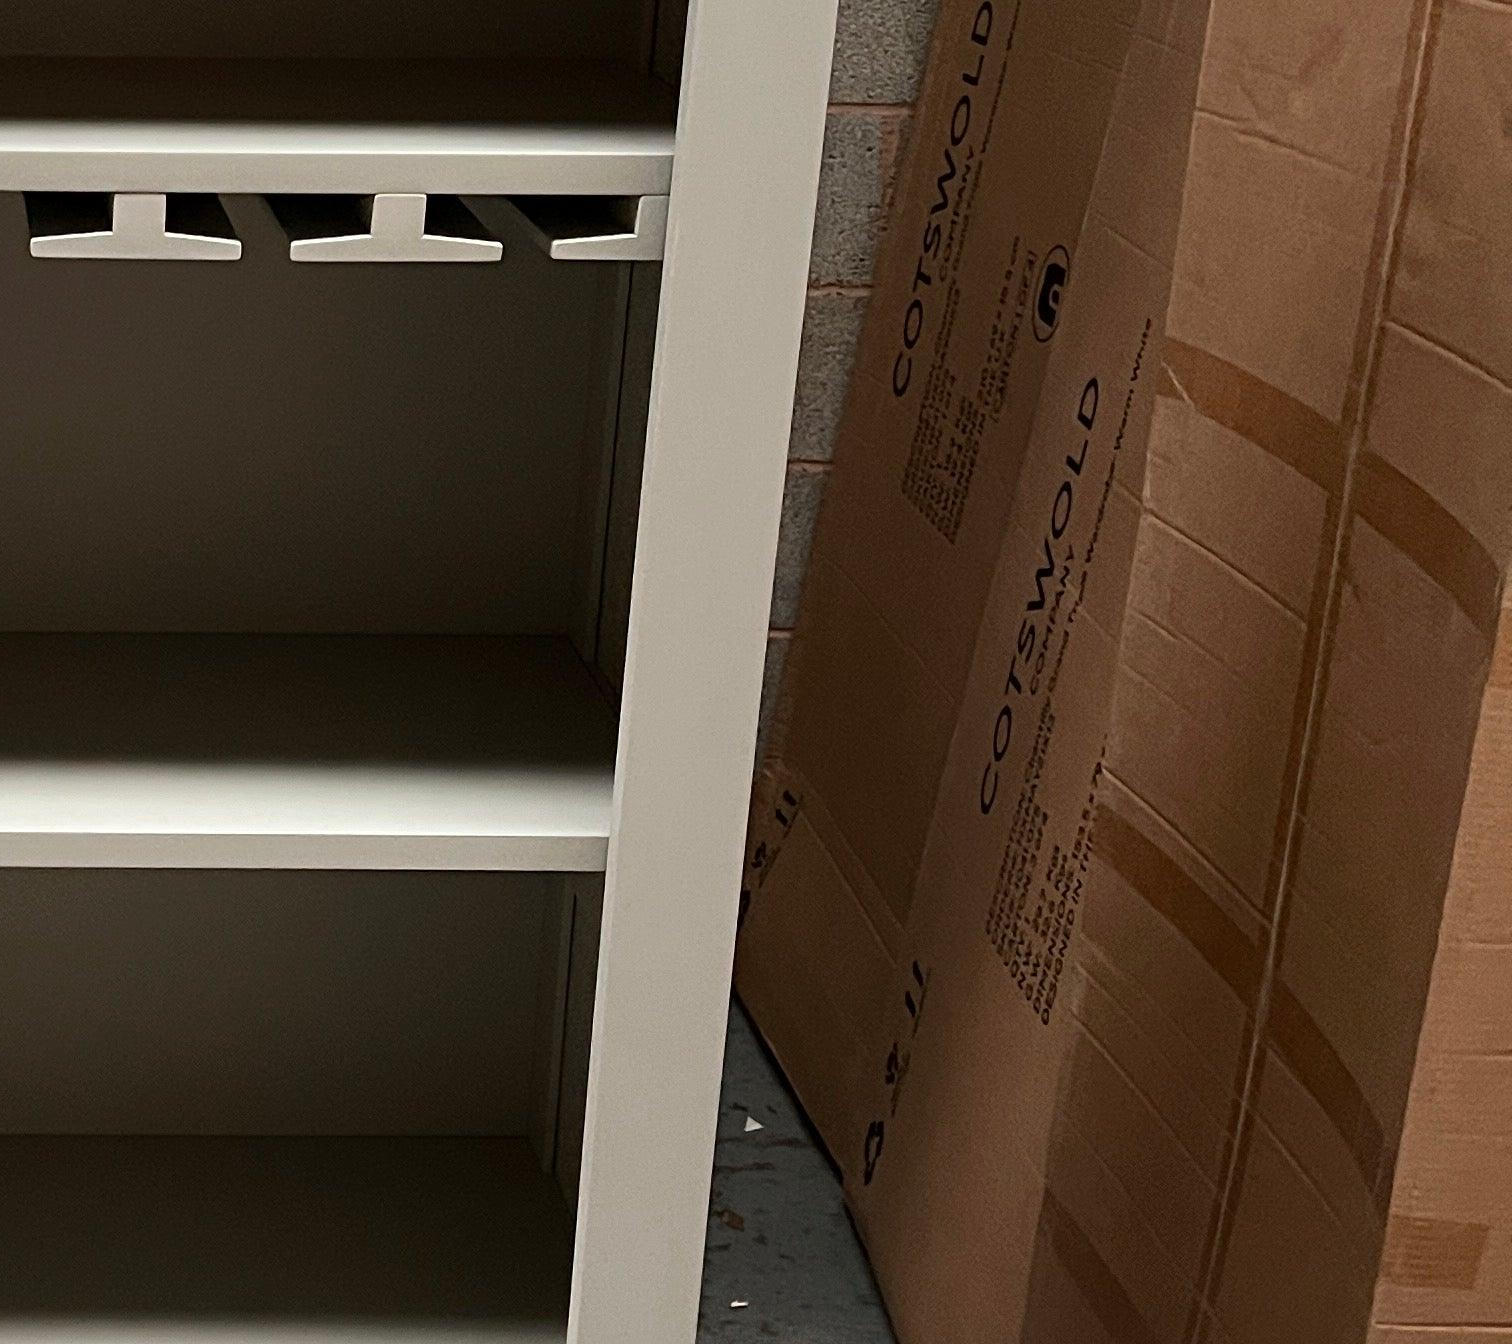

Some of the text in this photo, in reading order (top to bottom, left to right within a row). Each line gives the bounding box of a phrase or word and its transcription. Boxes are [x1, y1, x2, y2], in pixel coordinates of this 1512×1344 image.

[892, 0, 992, 396] COTSWOLD
[937, 142, 975, 284] COMPANY
[980, 376, 1099, 814] COTSWOLD
[1028, 539, 1075, 702] COMPANY
[1040, 905, 1076, 1028] DESIGNED
